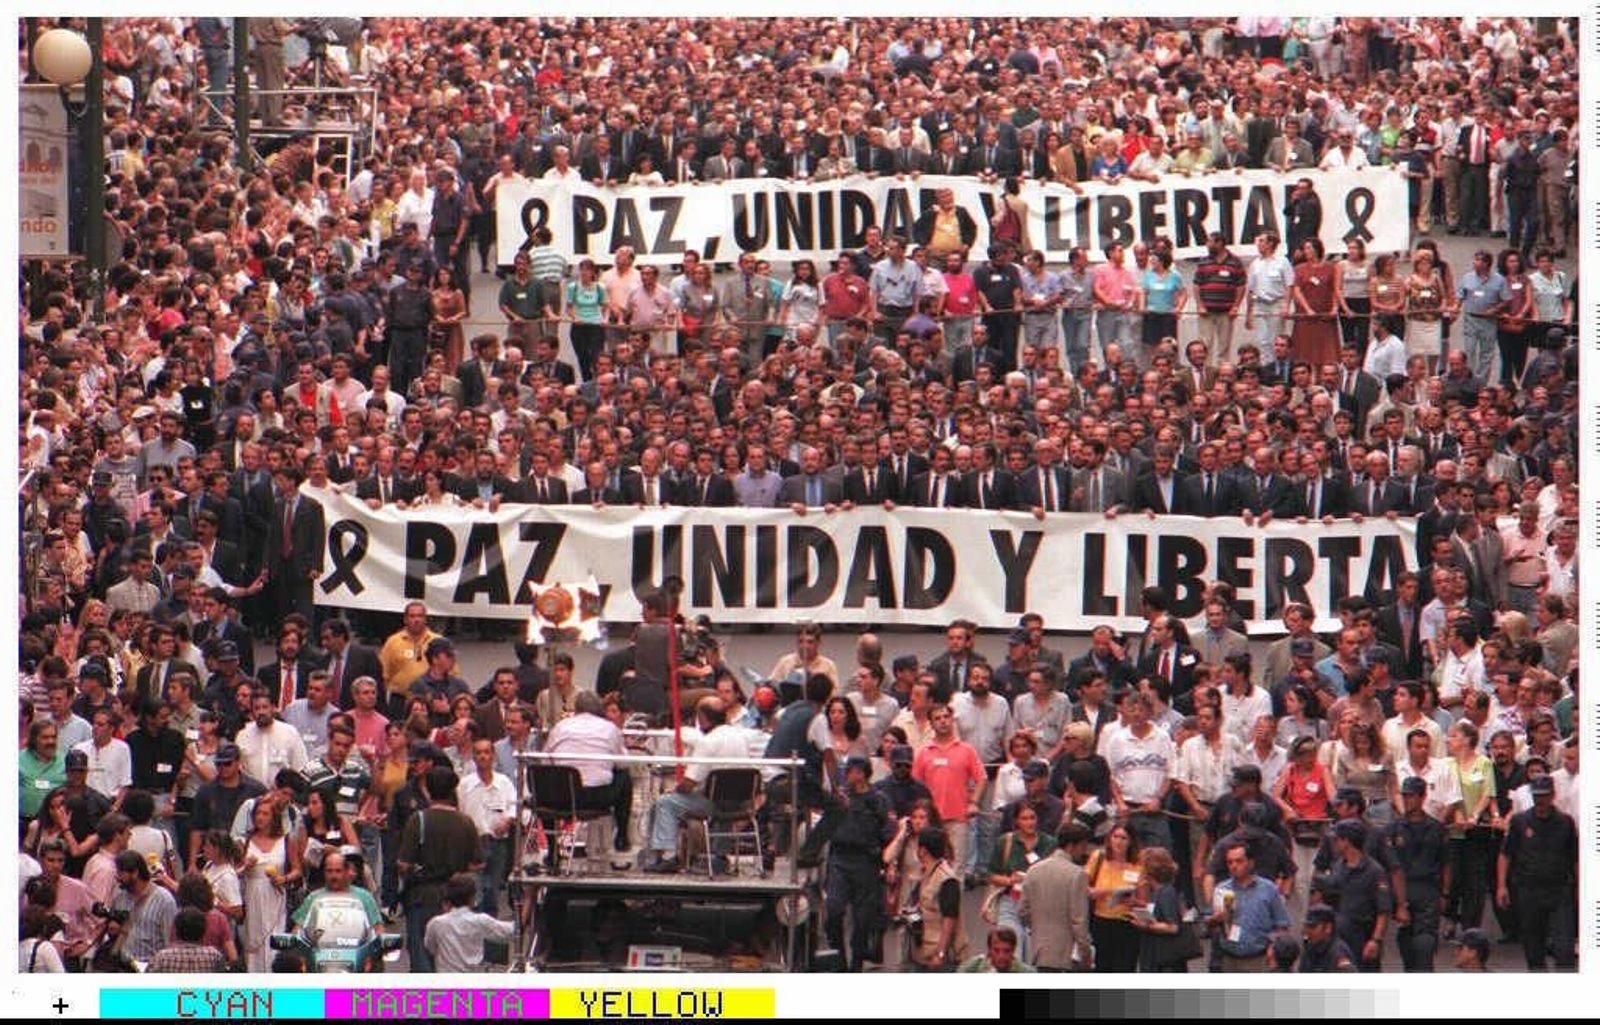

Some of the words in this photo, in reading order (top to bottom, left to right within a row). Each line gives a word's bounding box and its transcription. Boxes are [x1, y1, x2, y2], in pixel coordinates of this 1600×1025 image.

[1045, 185, 1301, 250] LIBERTA
[632, 524, 956, 610] UNIDAD
[990, 529, 1042, 613] Y
